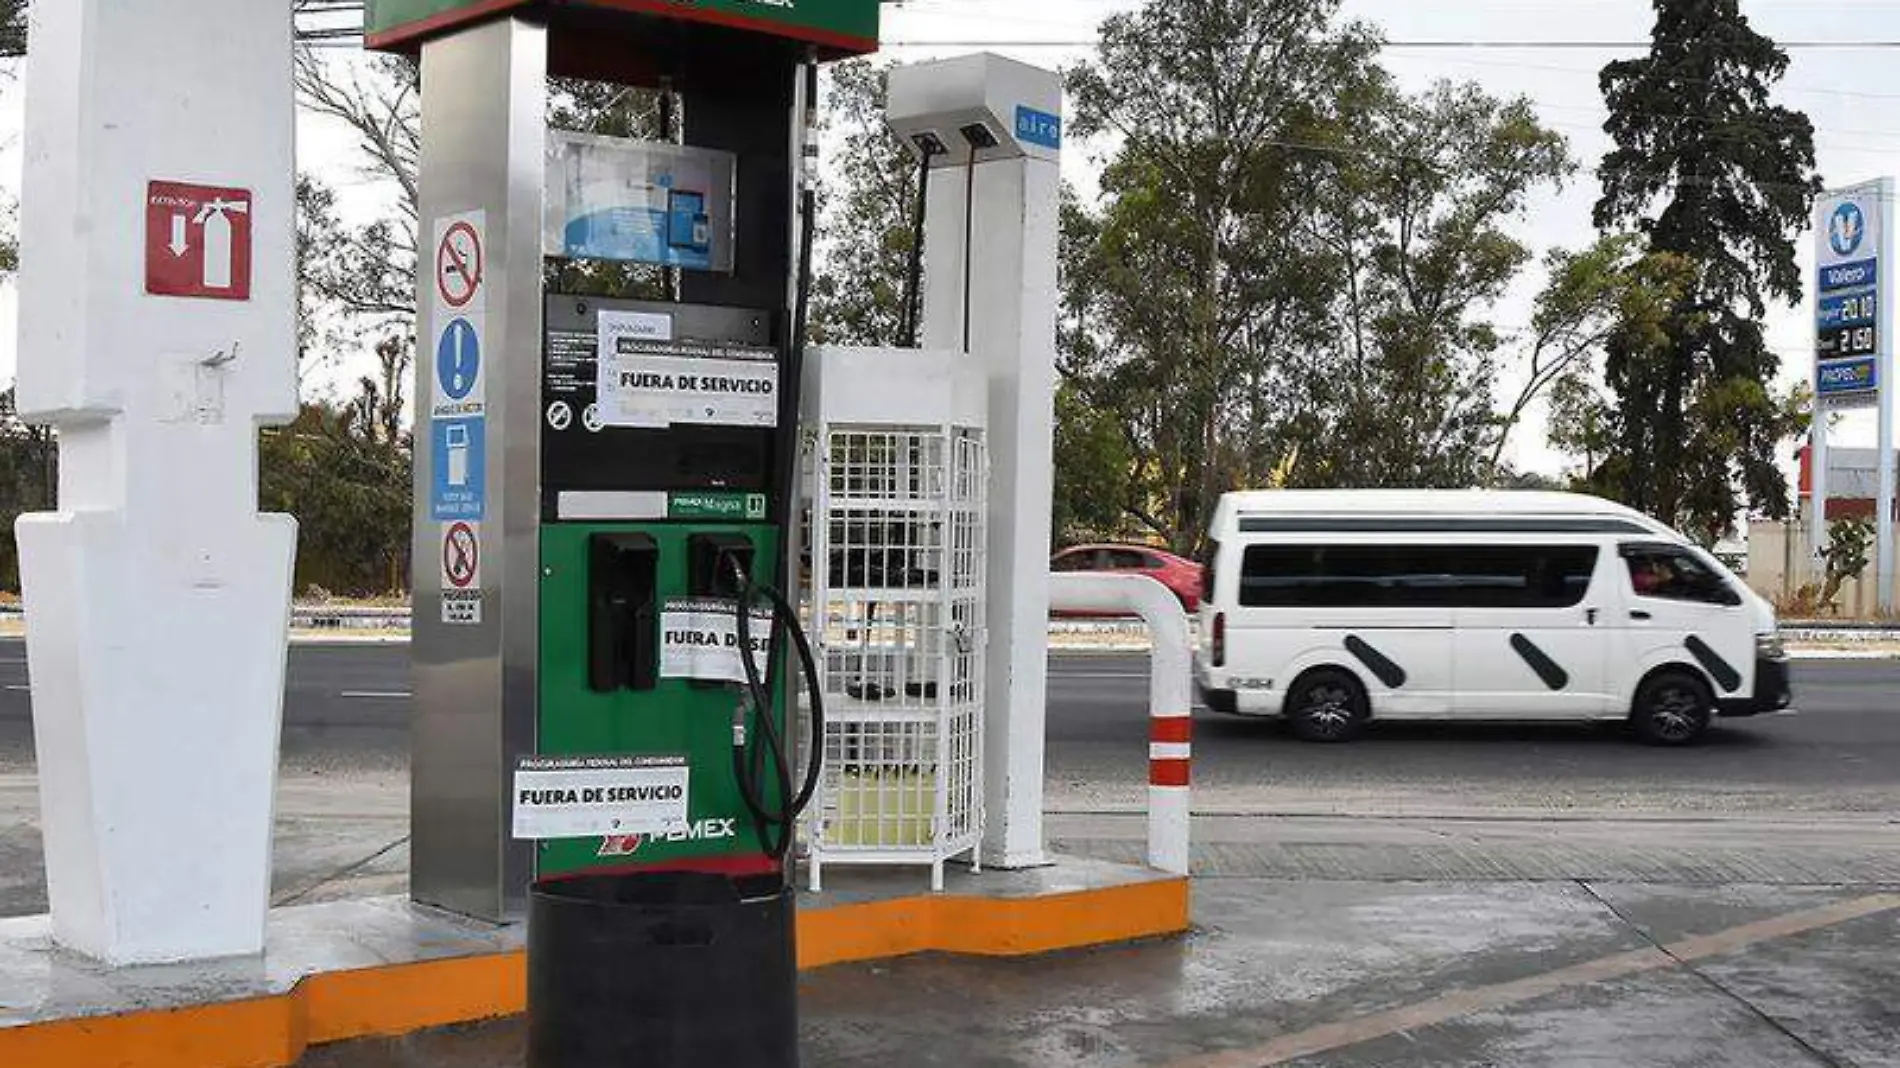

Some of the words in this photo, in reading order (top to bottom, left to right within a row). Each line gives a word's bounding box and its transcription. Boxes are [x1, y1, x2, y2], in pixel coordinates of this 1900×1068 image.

[1827, 267, 1866, 284] Valero
[620, 370, 674, 390] FUERA
[677, 374, 698, 391] DE
[700, 374, 773, 395] SERVICIO
[664, 631, 720, 646] FUERA
[519, 788, 578, 806] FUERA
[582, 787, 605, 803] DE
[607, 784, 683, 803] SERVICIO
